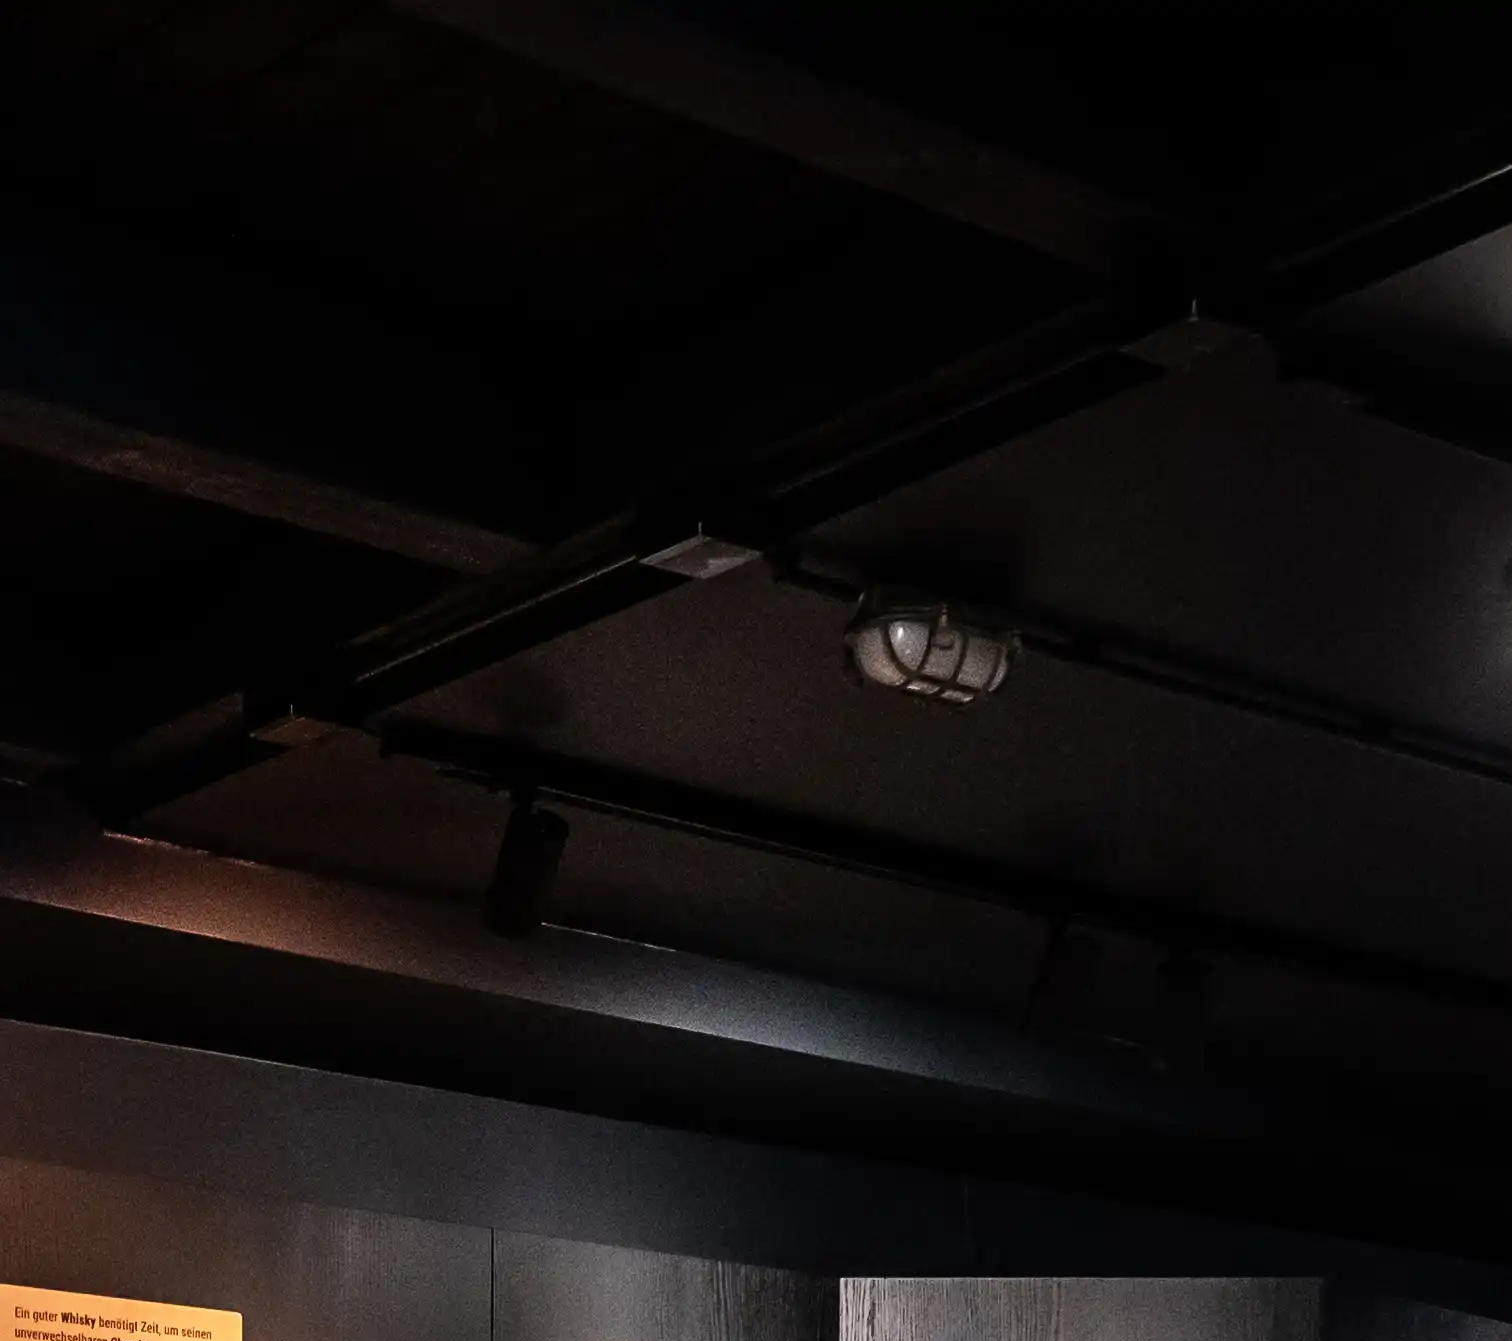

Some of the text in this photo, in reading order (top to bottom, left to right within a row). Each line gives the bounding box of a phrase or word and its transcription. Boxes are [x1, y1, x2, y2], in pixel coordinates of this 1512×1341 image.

[14, 1306, 212, 1340] Ein guter Whisky benötigt Zeit, um seinen
